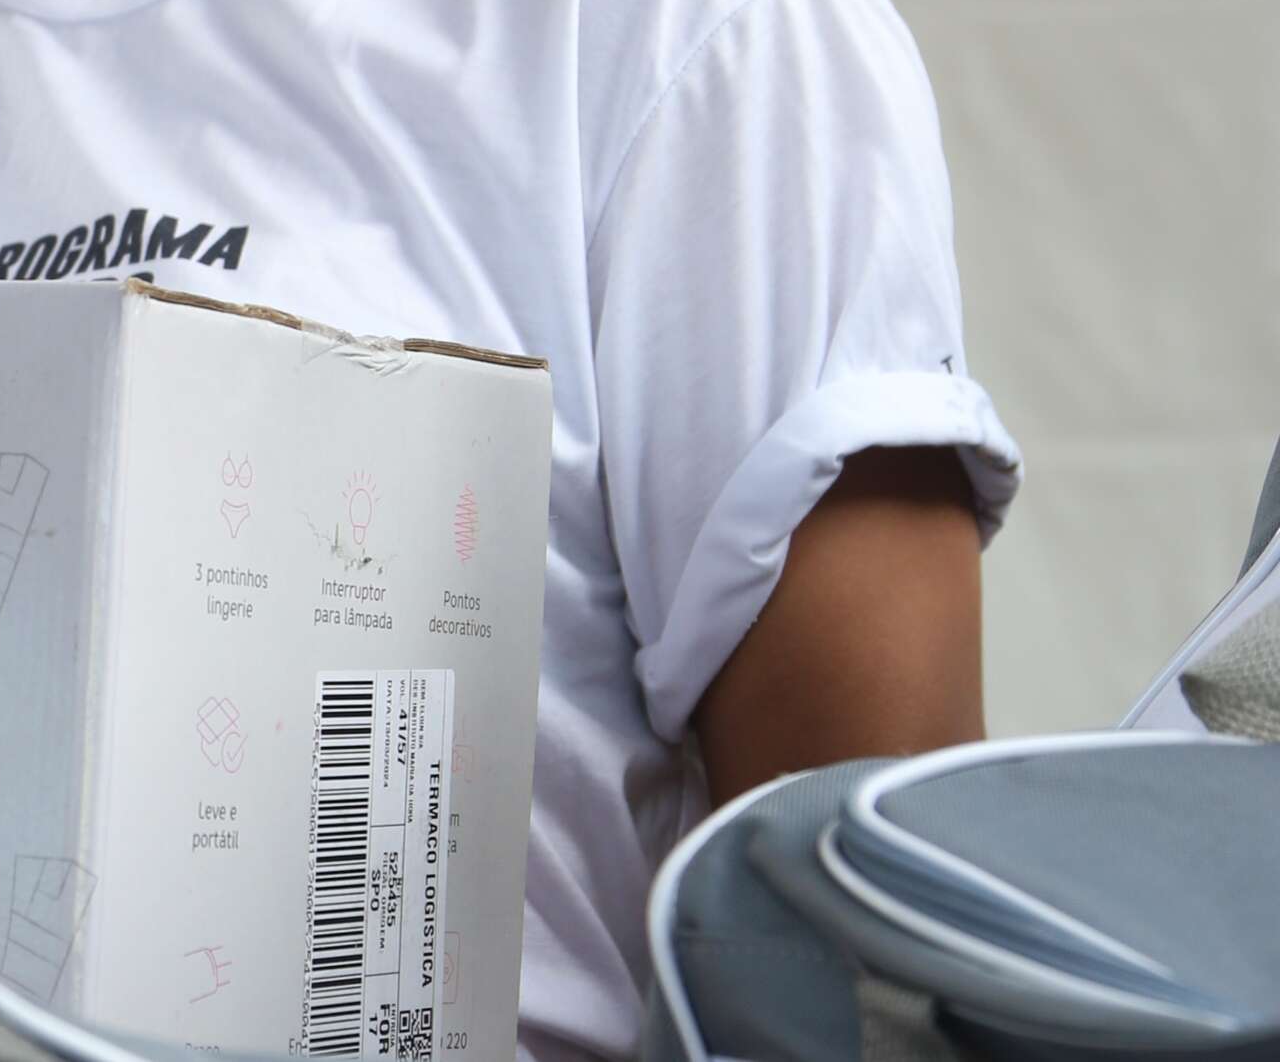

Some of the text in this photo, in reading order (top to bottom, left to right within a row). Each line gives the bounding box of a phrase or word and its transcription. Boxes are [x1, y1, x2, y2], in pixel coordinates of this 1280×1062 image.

[194, 563, 268, 590] 3 pontinhos
[321, 578, 386, 603] Interruptor
[444, 590, 480, 611] Pontos
[207, 595, 253, 622] lingerie
[314, 607, 393, 631] para lâmpada
[429, 614, 492, 639] decorativos
[397, 709, 407, 765] 41/57
[199, 799, 226, 820] Leve
[192, 829, 239, 853] portátil
[422, 760, 441, 987] TERMACO LOGISTICA
[370, 870, 381, 912] SPO
[386, 852, 398, 927] 525435
[368, 1014, 378, 1036] 17
[378, 1004, 390, 1055] FOR
[447, 1032, 468, 1050] 220
